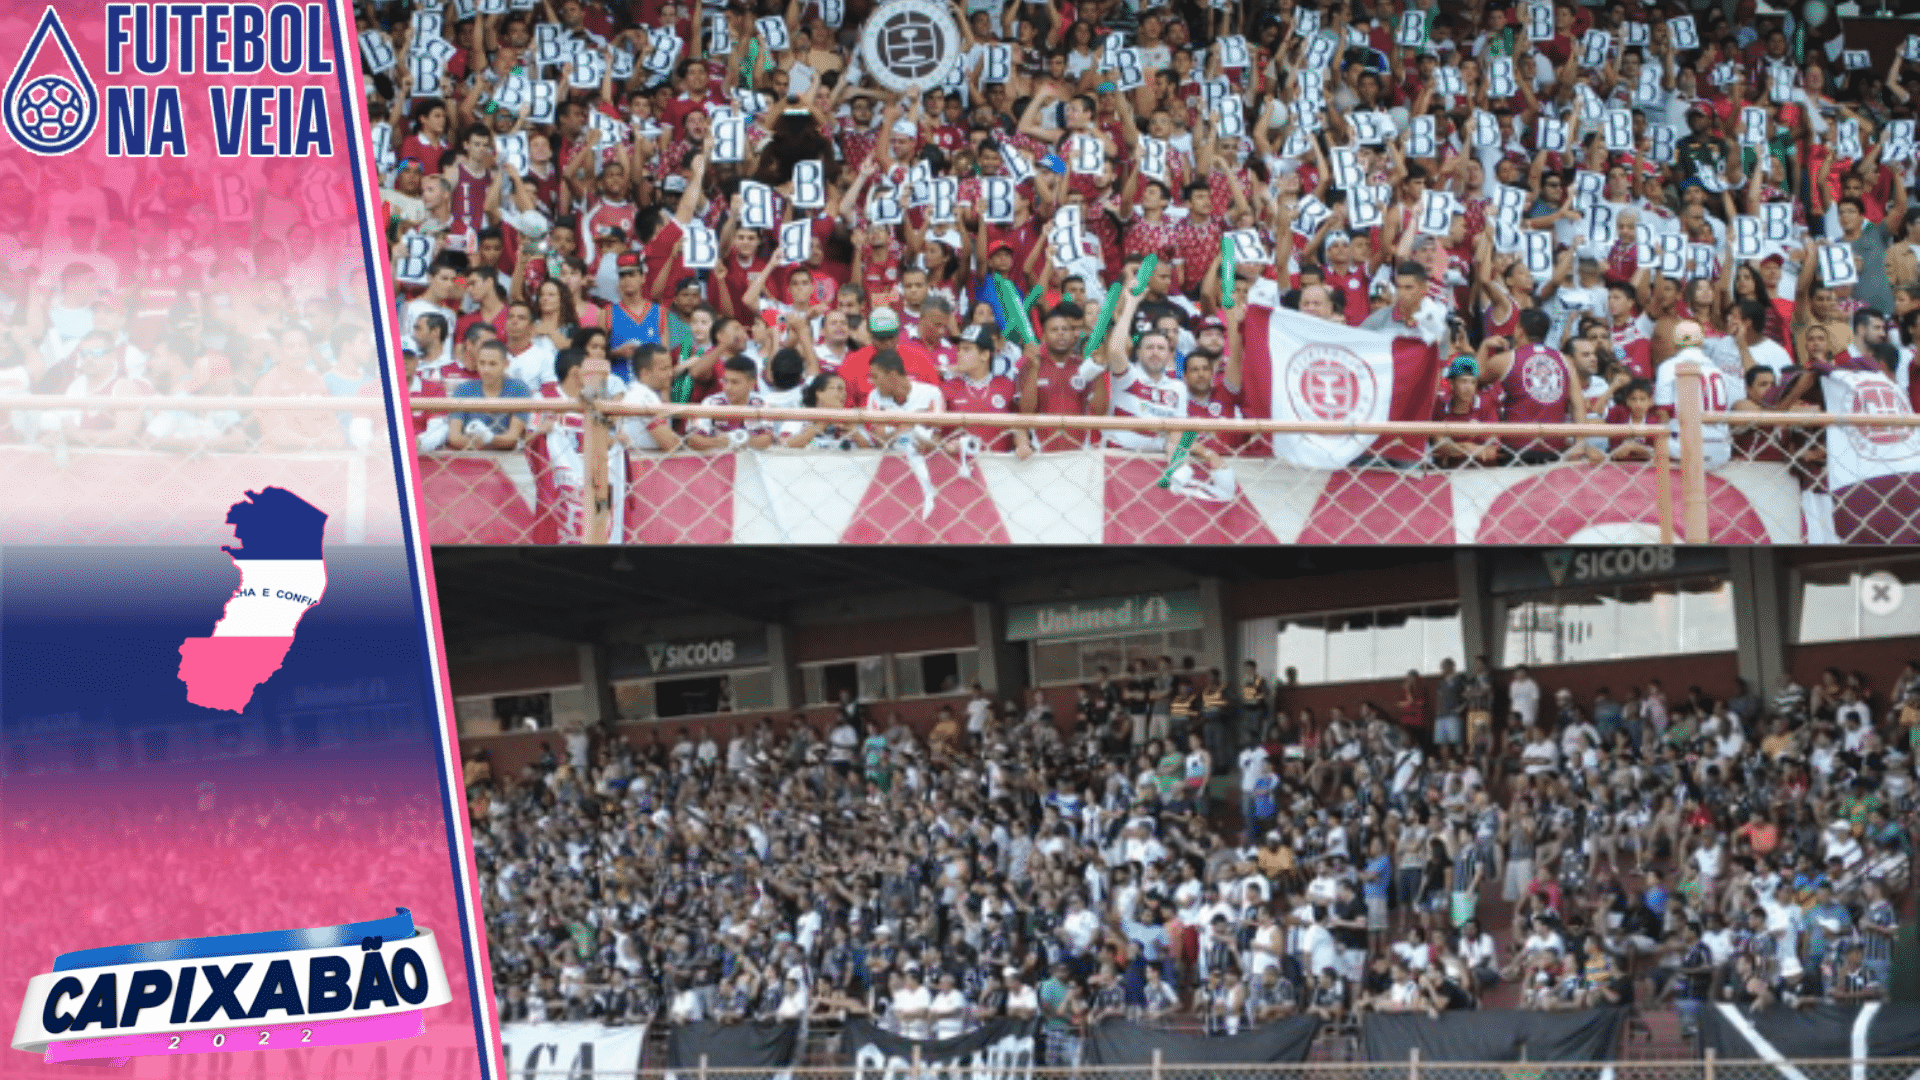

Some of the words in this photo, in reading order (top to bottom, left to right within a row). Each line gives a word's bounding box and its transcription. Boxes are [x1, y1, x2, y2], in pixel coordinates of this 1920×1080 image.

[714, 14, 728, 50] B
[761, 20, 785, 47] B
[1402, 12, 1421, 43] B
[1532, 7, 1552, 38] B
[1672, 17, 1694, 46] B
[538, 25, 559, 60] B
[1224, 37, 1246, 64] B
[1308, 37, 1329, 70] B
[1584, 31, 1606, 64] B
[418, 55, 439, 93] B
[573, 51, 595, 83] B
[989, 47, 1008, 80] B
[1117, 51, 1141, 85] B
[1493, 59, 1512, 96] B
[532, 80, 551, 118] B
[1640, 65, 1658, 102] B
[1221, 97, 1241, 134] B
[1298, 100, 1318, 131] B
[1477, 111, 1499, 147] B
[1611, 112, 1631, 148] B
[1745, 109, 1764, 144] B
[1079, 136, 1099, 170] B
[1411, 117, 1433, 155] B
[1653, 125, 1673, 161] B
[1144, 139, 1163, 173] B
[1339, 150, 1363, 187] B
[798, 163, 819, 203] B
[910, 164, 930, 203] B
[934, 180, 955, 219] B
[989, 178, 1011, 219] B
[1355, 186, 1377, 222] B
[1424, 191, 1449, 230] B
[1767, 204, 1788, 240] B
[1590, 206, 1611, 242] B
[1738, 218, 1760, 254] B
[400, 237, 429, 278] B
[689, 226, 715, 263] B
[1234, 232, 1266, 260] B
[1528, 233, 1549, 271] B
[1662, 234, 1682, 272] B
[1826, 245, 1854, 281] B
[1574, 547, 1675, 579] SICOOB
[1037, 600, 1132, 633] Unimed
[666, 640, 736, 668] SICOOB
